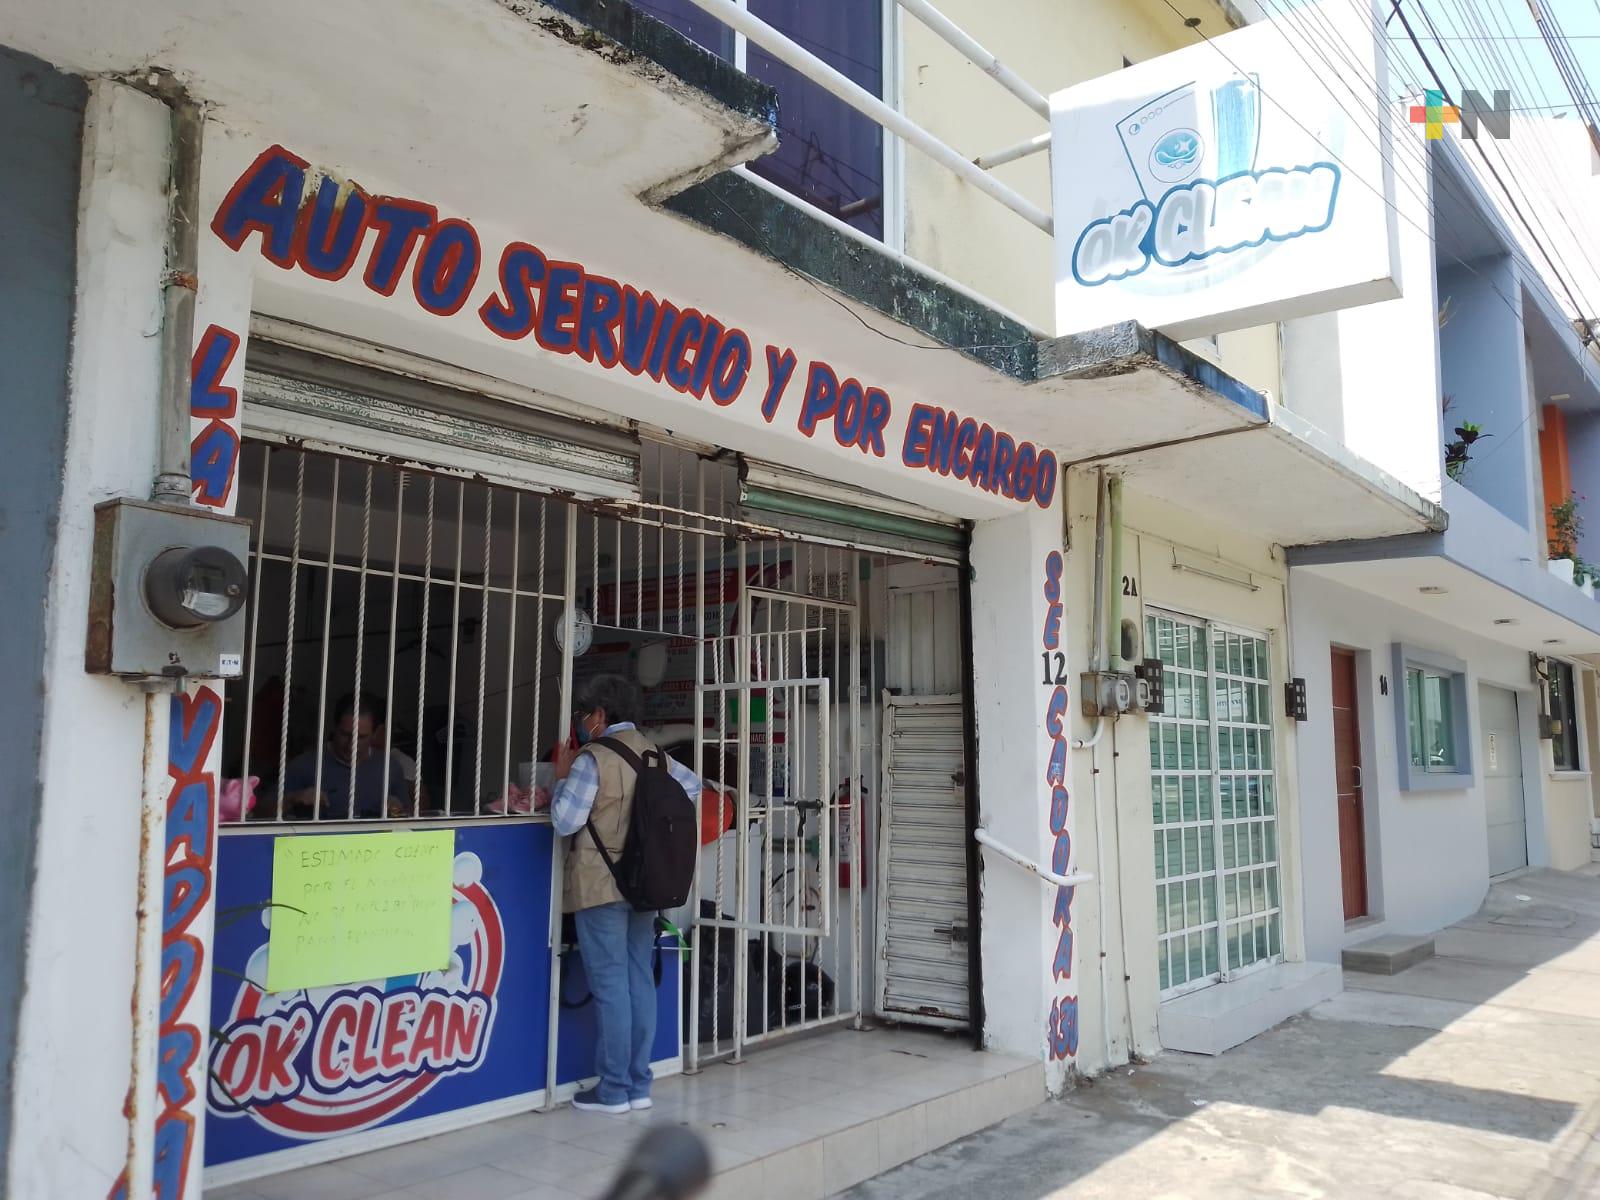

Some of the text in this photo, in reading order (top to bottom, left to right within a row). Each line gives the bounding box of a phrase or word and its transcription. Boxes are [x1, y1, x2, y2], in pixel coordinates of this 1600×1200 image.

[1076, 205, 1149, 282] OK
[211, 144, 1057, 508] AUTO SERVICIO Y POR ENCARGO
[1042, 651, 1068, 686] 12
[217, 997, 484, 1099] OK CLEAN
